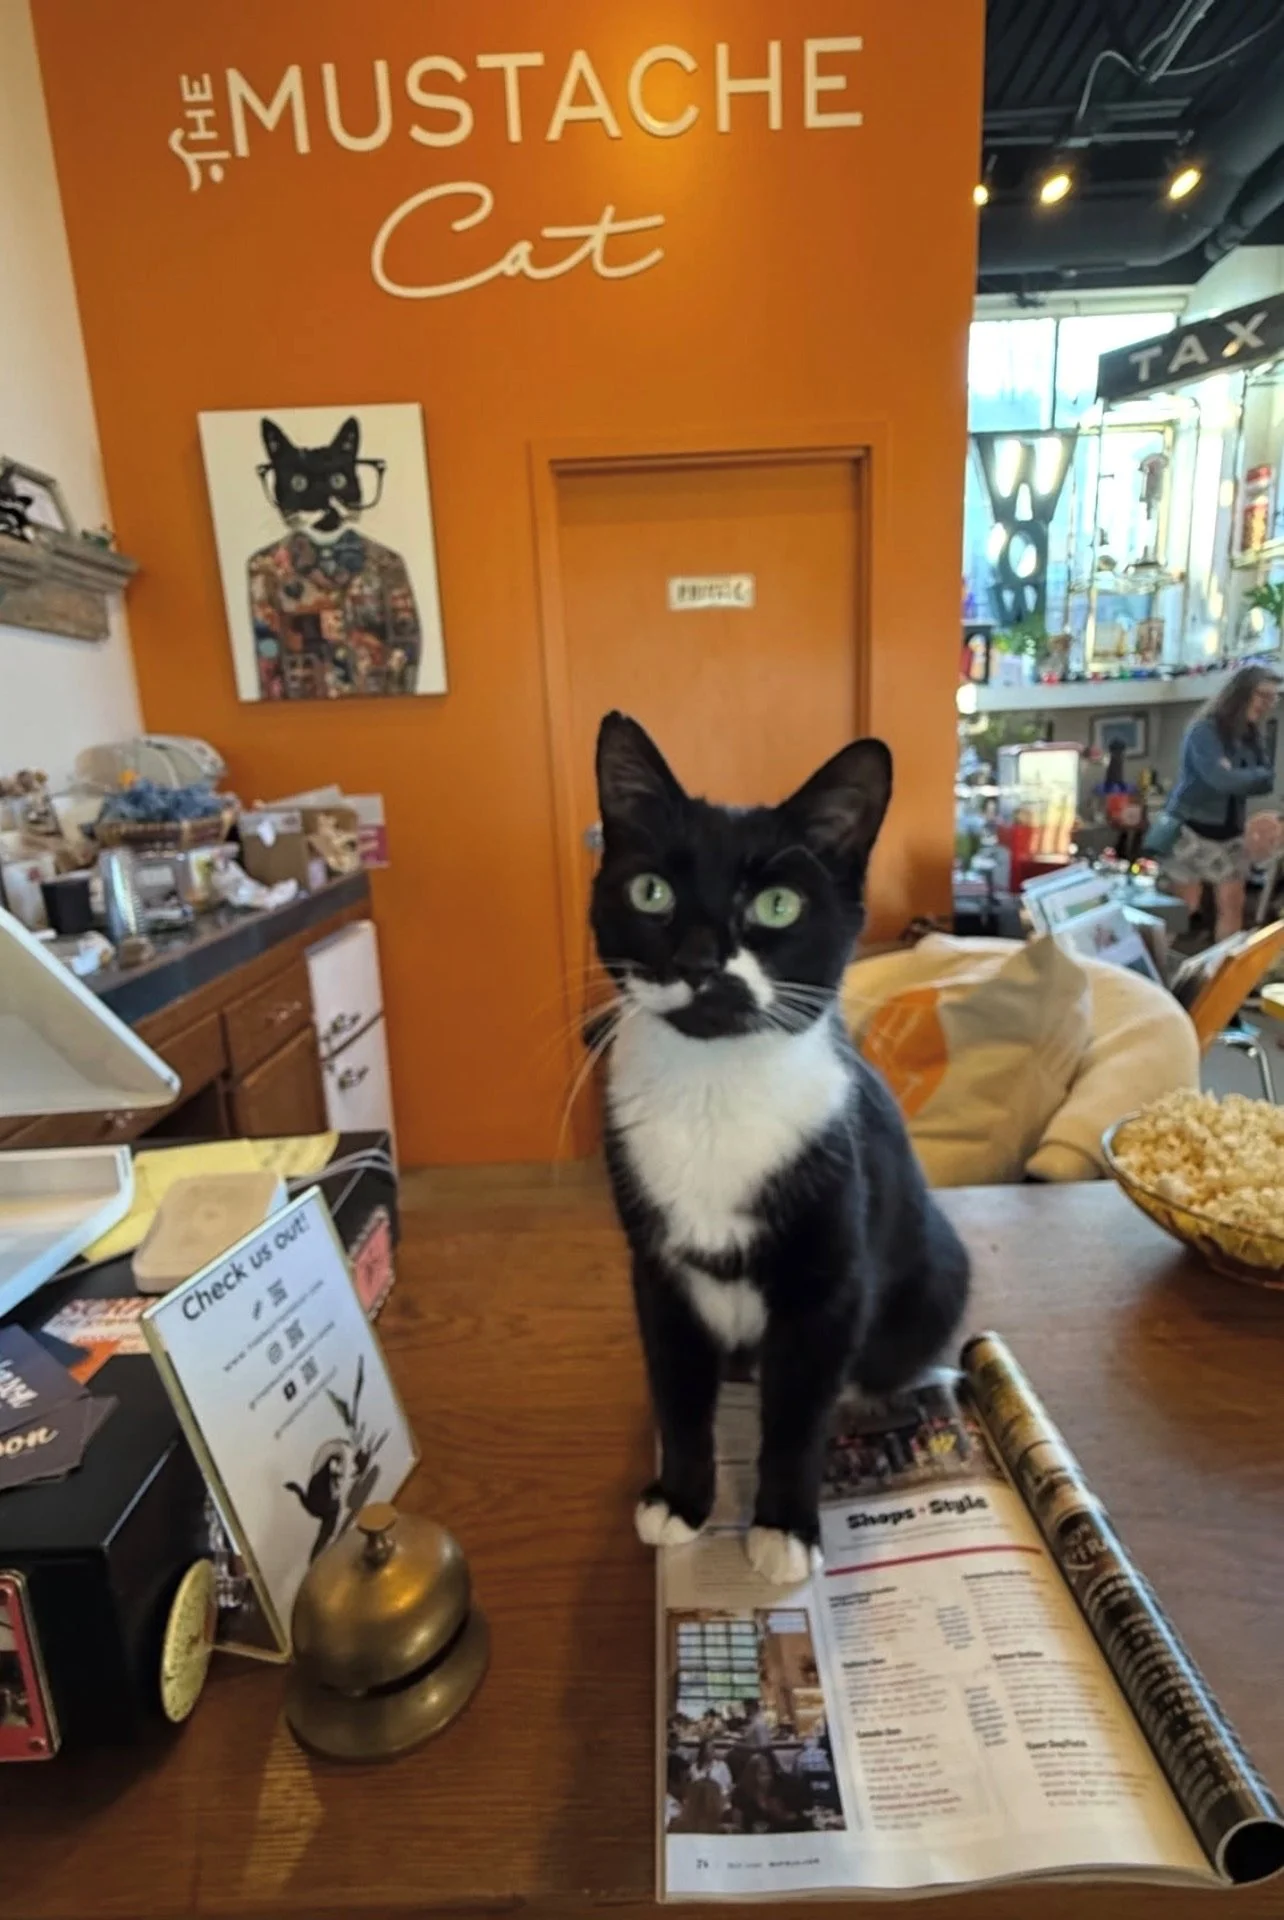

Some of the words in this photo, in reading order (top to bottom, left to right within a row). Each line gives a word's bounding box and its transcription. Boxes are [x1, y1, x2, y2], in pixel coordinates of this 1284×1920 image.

[168, 73, 231, 192] THE
[226, 36, 864, 158] MUSTACHE
[370, 181, 666, 299] Cat
[1128, 311, 1269, 382] TAX
[182, 1261, 249, 1322] Check
[249, 1241, 273, 1271] us
[273, 1211, 311, 1251] out!
[847, 1506, 917, 1531] Shops
[927, 1493, 989, 1517] Style
